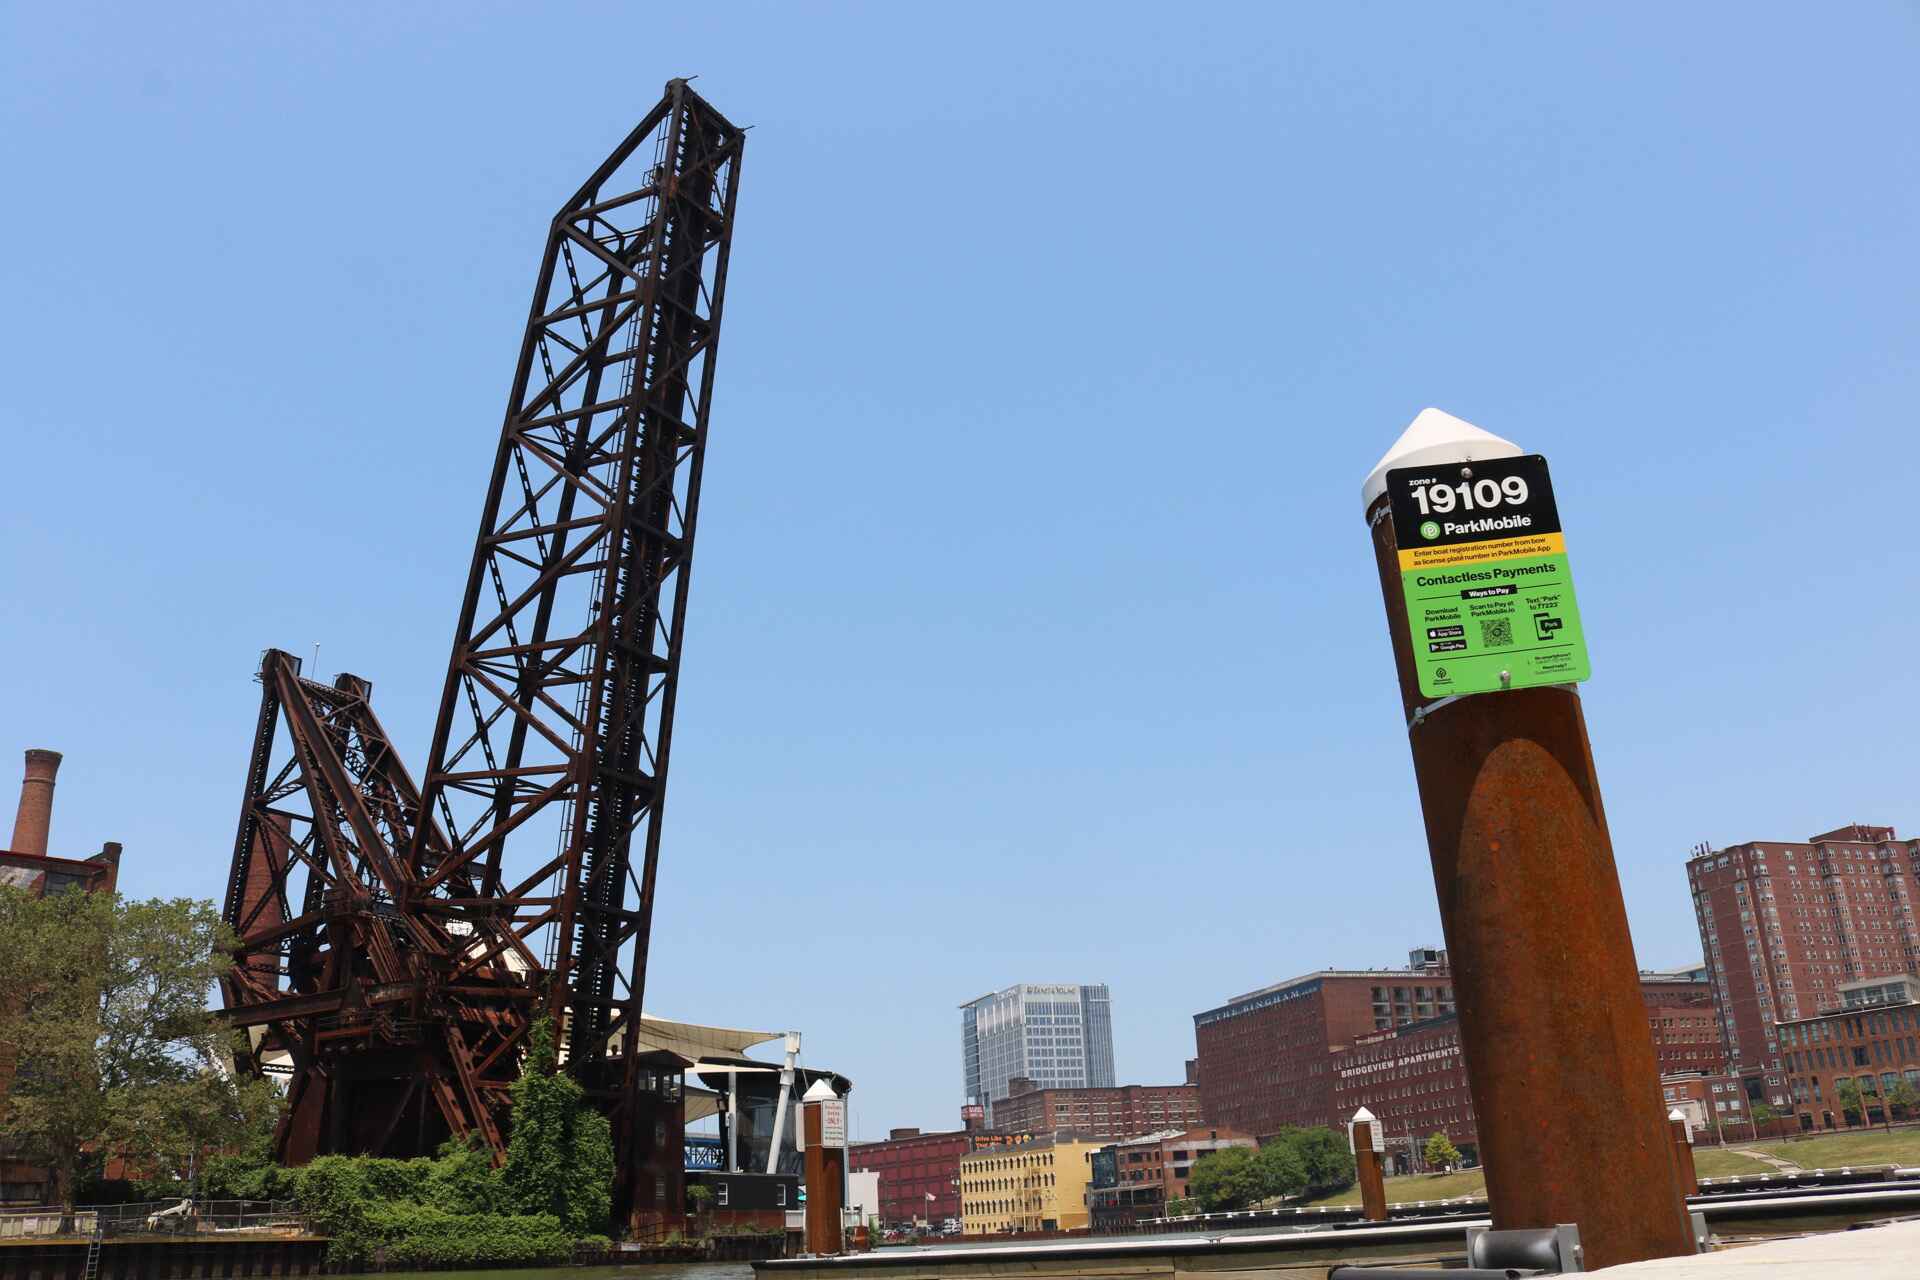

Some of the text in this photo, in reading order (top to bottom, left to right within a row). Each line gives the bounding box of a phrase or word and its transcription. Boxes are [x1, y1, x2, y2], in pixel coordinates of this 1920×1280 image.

[1408, 478, 1430, 486] zone
[1411, 476, 1529, 515] 19109
[1443, 514, 1531, 535] ParkMobile
[1414, 550, 1432, 558] Enter
[1449, 544, 1488, 555] registration
[1488, 541, 1514, 549] number
[1422, 557, 1447, 566] license
[1447, 555, 1464, 565] plate
[1464, 552, 1490, 561] number
[1491, 550, 1498, 558] in
[1498, 546, 1536, 557] ParkMobile
[1537, 544, 1551, 553] App
[1416, 562, 1556, 587] Contactless Payments
[1468, 590, 1488, 598] Ways
[1496, 587, 1510, 596] Pay
[1425, 606, 1458, 615] Download
[1341, 1046, 1461, 1079] BRIDGEVIEW APARTMENTS
